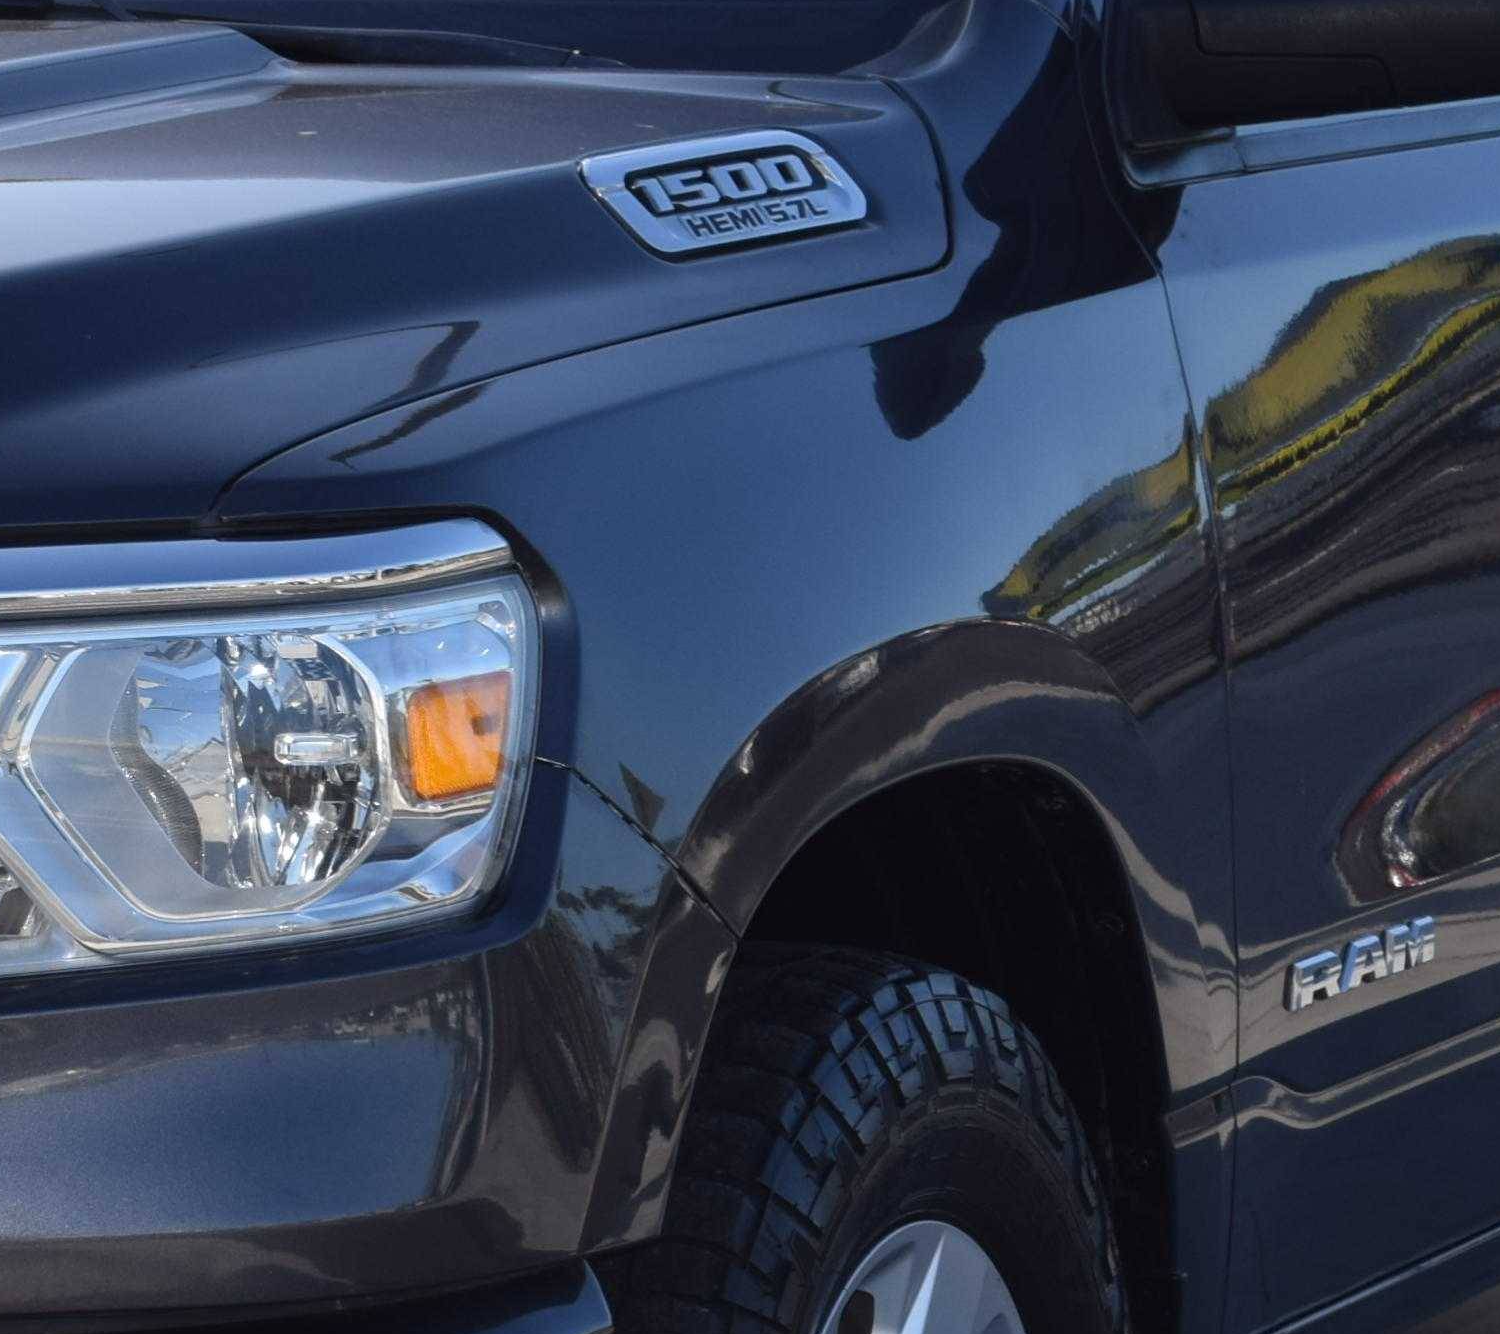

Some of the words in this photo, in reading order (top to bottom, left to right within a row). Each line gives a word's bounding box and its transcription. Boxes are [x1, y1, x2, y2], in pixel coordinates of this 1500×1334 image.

[631, 154, 813, 213] 1500
[686, 201, 765, 238] HEMI
[766, 197, 828, 224] 5.7L
[1288, 916, 1435, 1012] RAM
